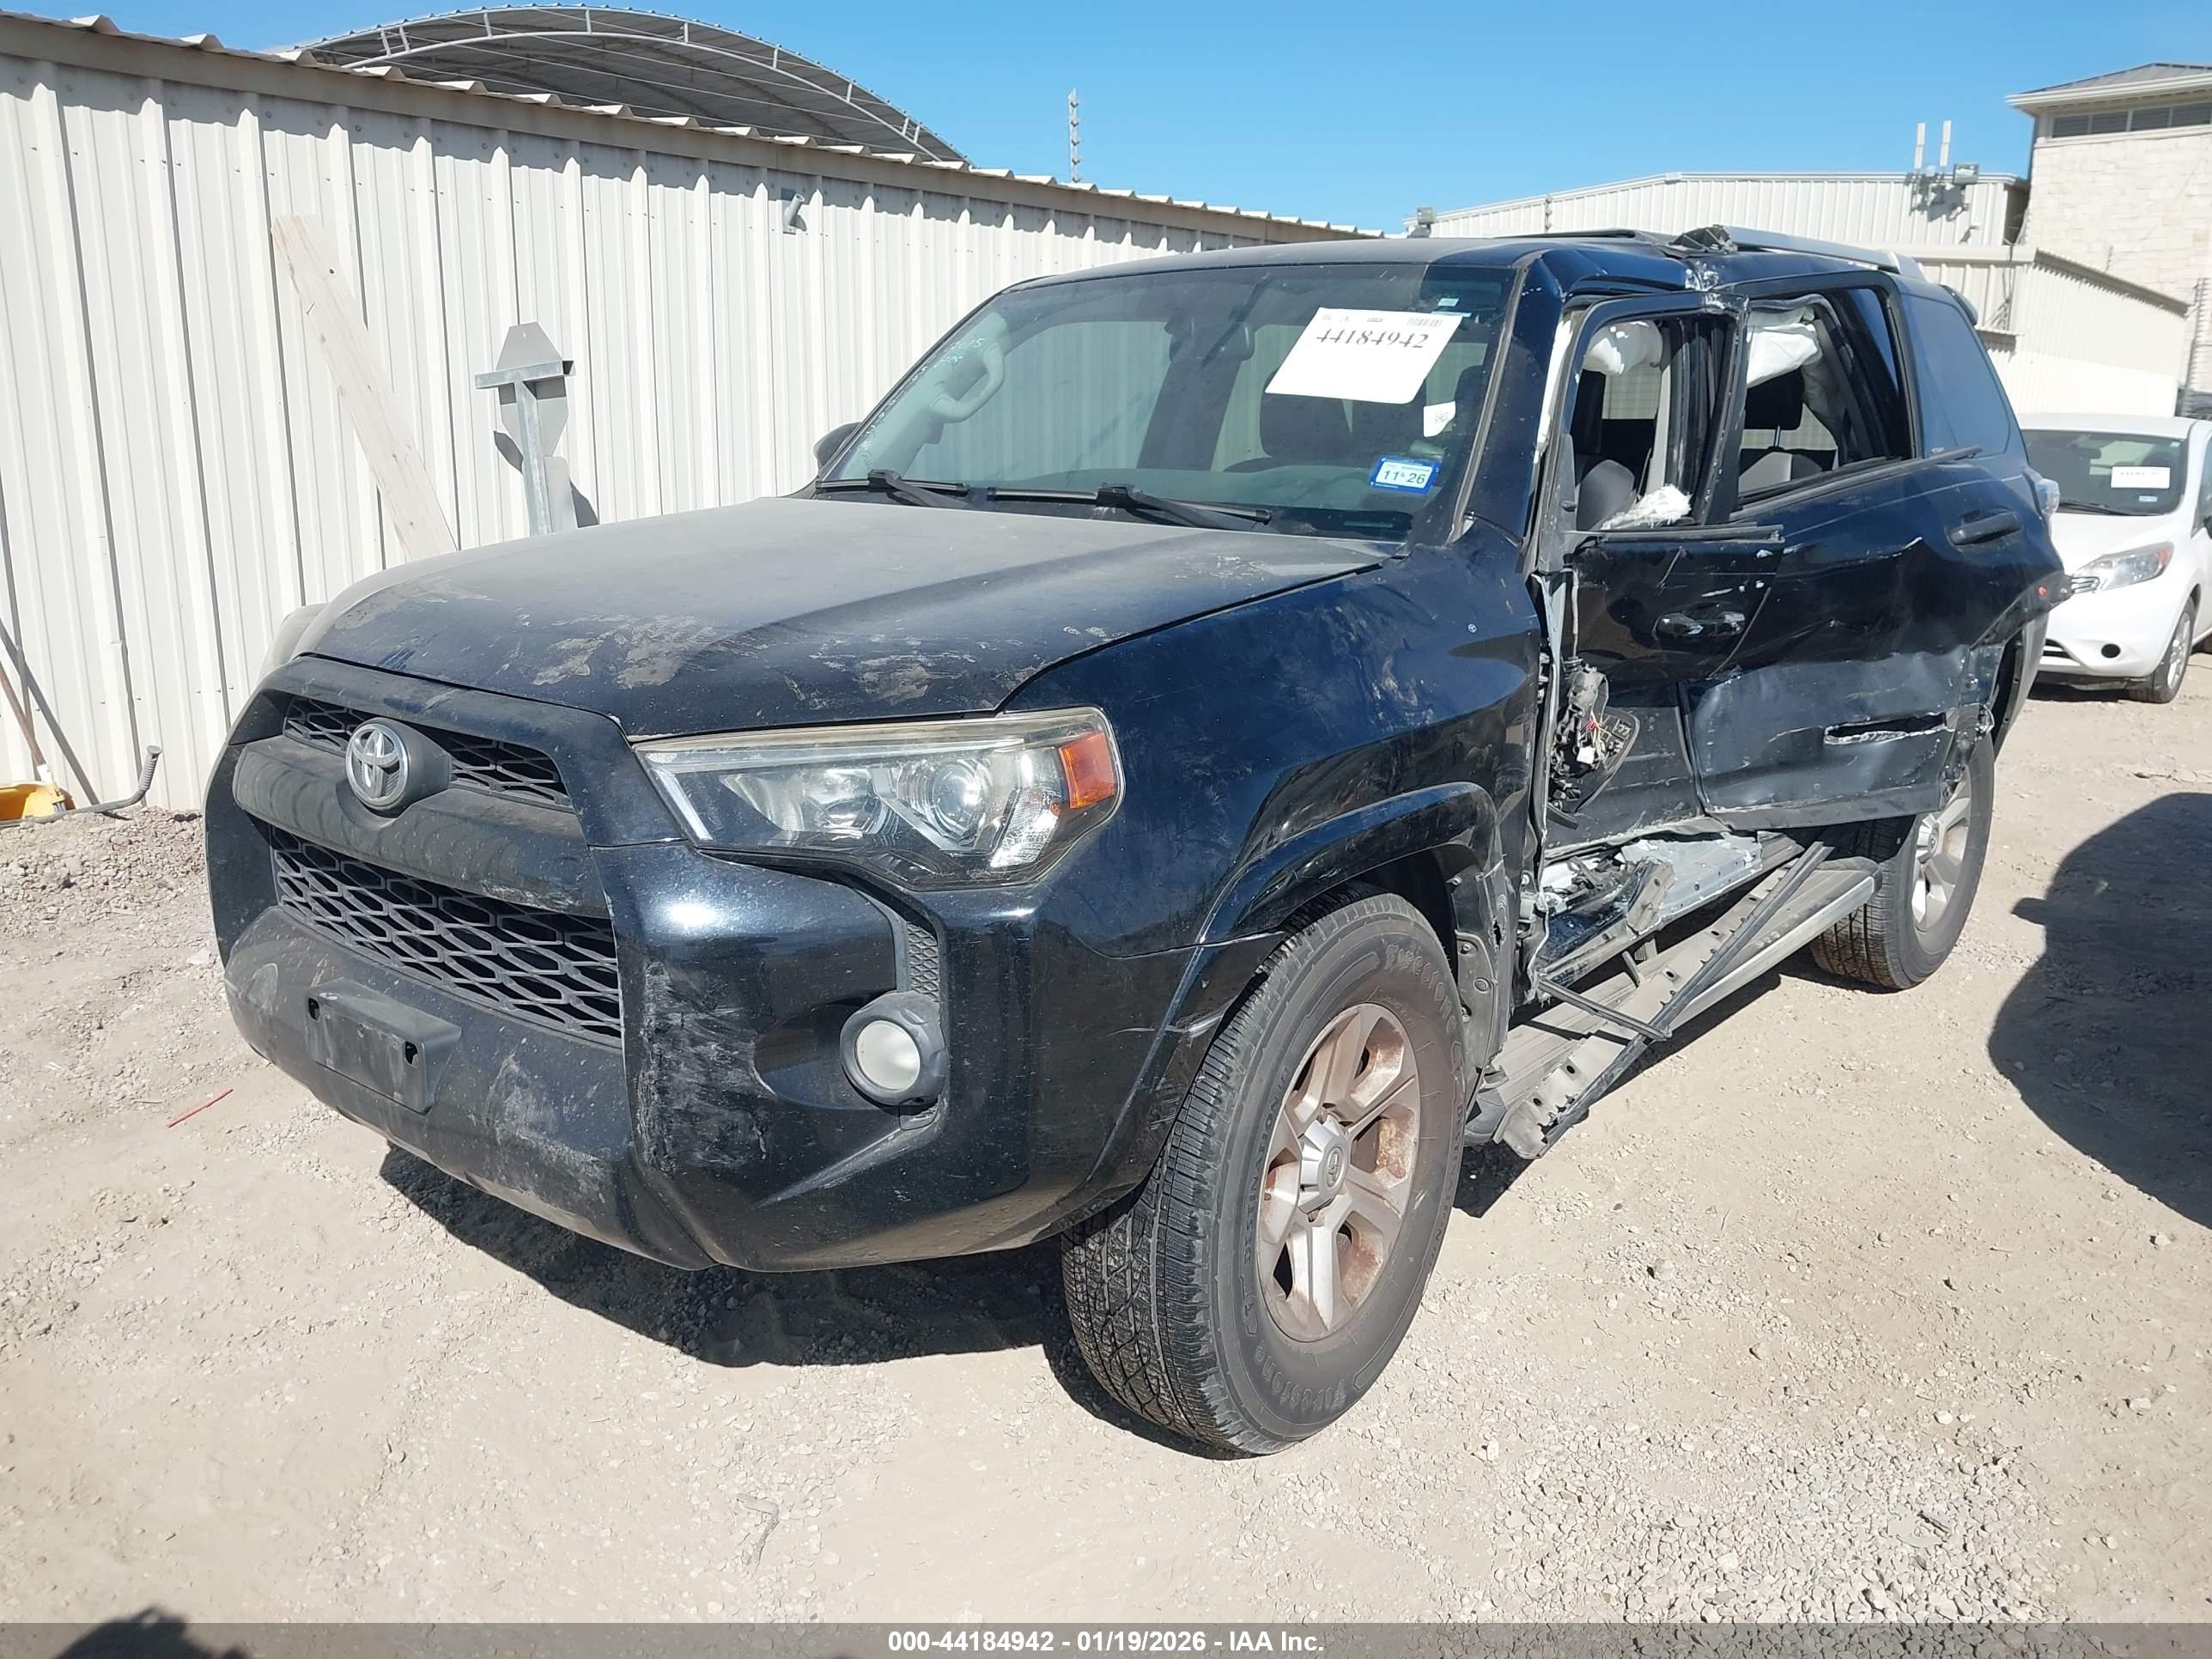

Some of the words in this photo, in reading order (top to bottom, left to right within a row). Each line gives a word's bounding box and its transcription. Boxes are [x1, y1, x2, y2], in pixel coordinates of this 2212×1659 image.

[1316, 328, 1430, 349] 44184942
[1406, 472, 1427, 485] 26
[1385, 944, 1458, 1035] Firestone
[1254, 1340, 1347, 1414] Firestone
